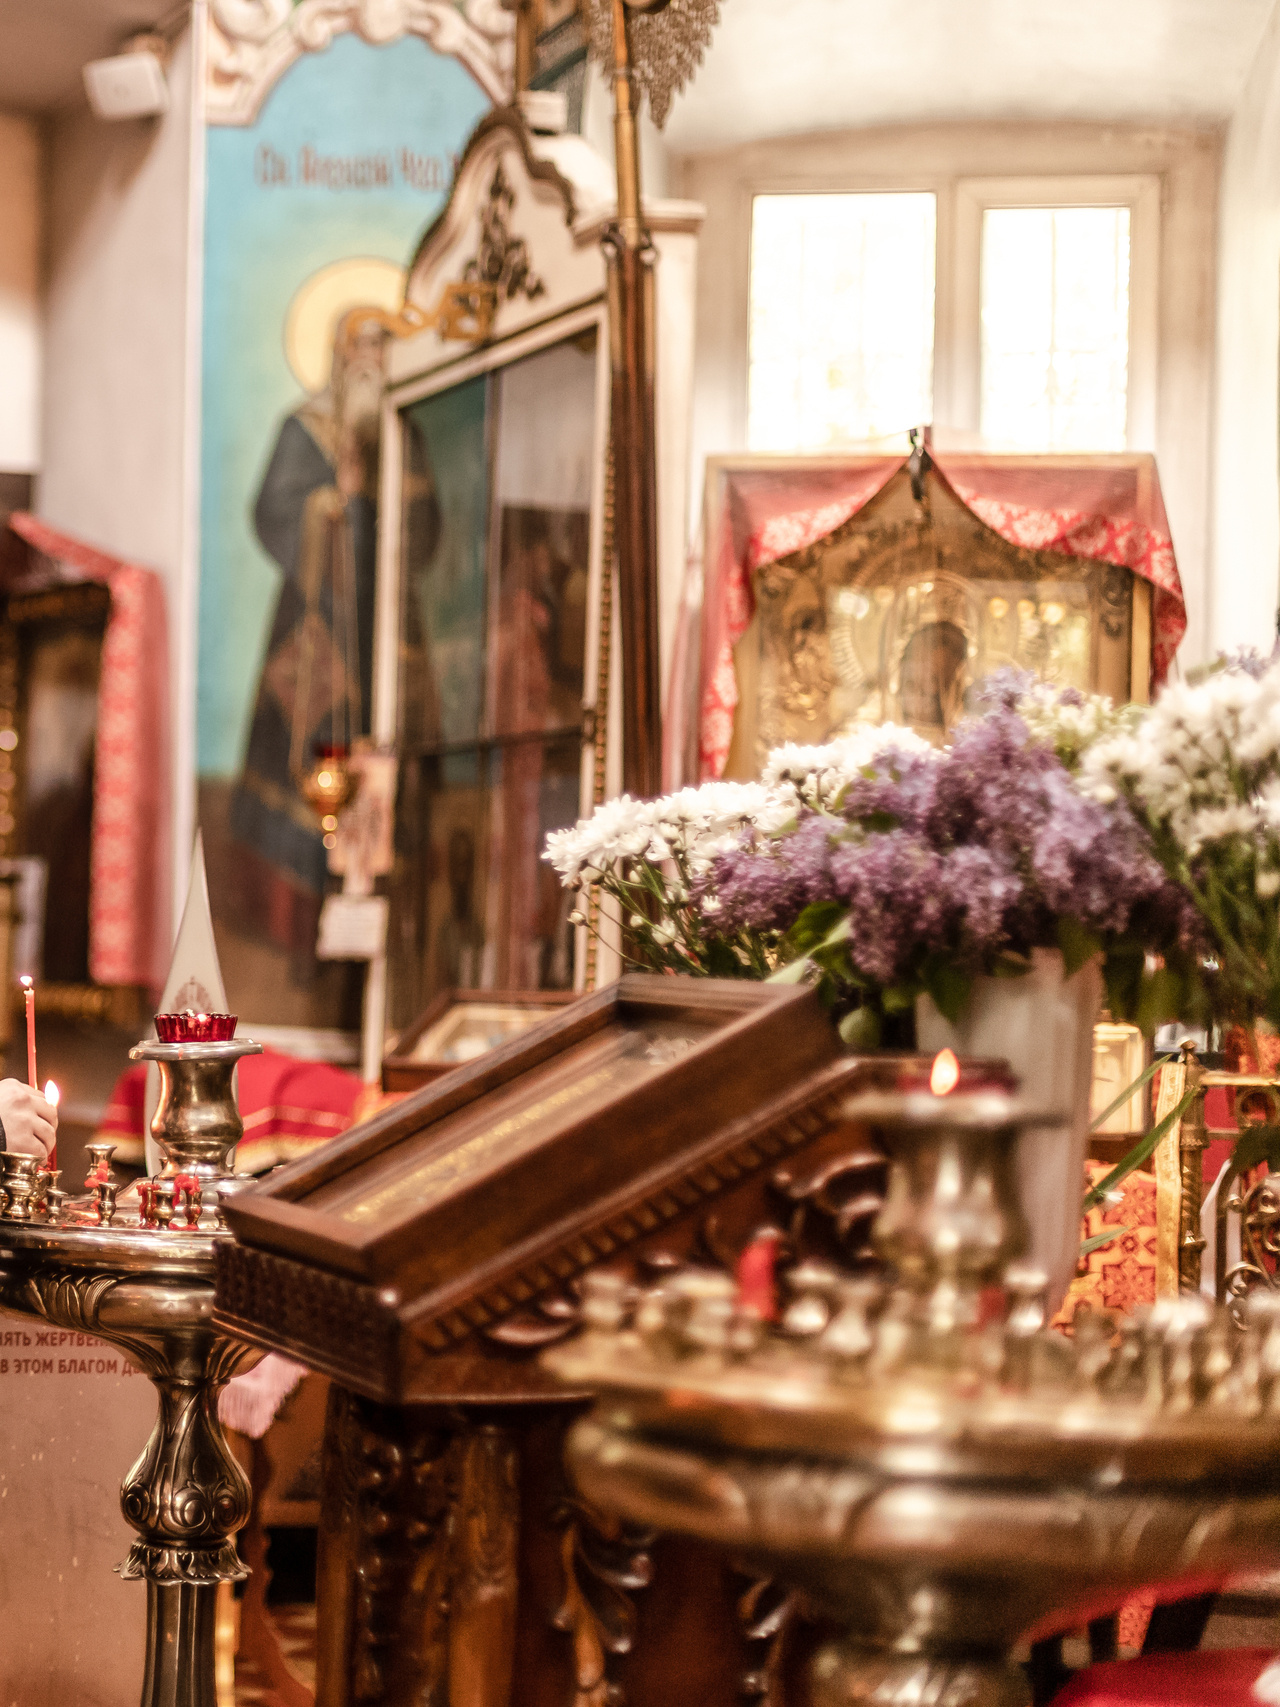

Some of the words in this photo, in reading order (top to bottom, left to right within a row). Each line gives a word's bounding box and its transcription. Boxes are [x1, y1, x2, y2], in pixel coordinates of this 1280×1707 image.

[36, 1331, 107, 1347] ЖЕРТВЕ
[0, 1359, 9, 1374] В
[14, 1359, 54, 1374] ЭТОМ
[58, 1359, 118, 1374] БЛАГОМ
